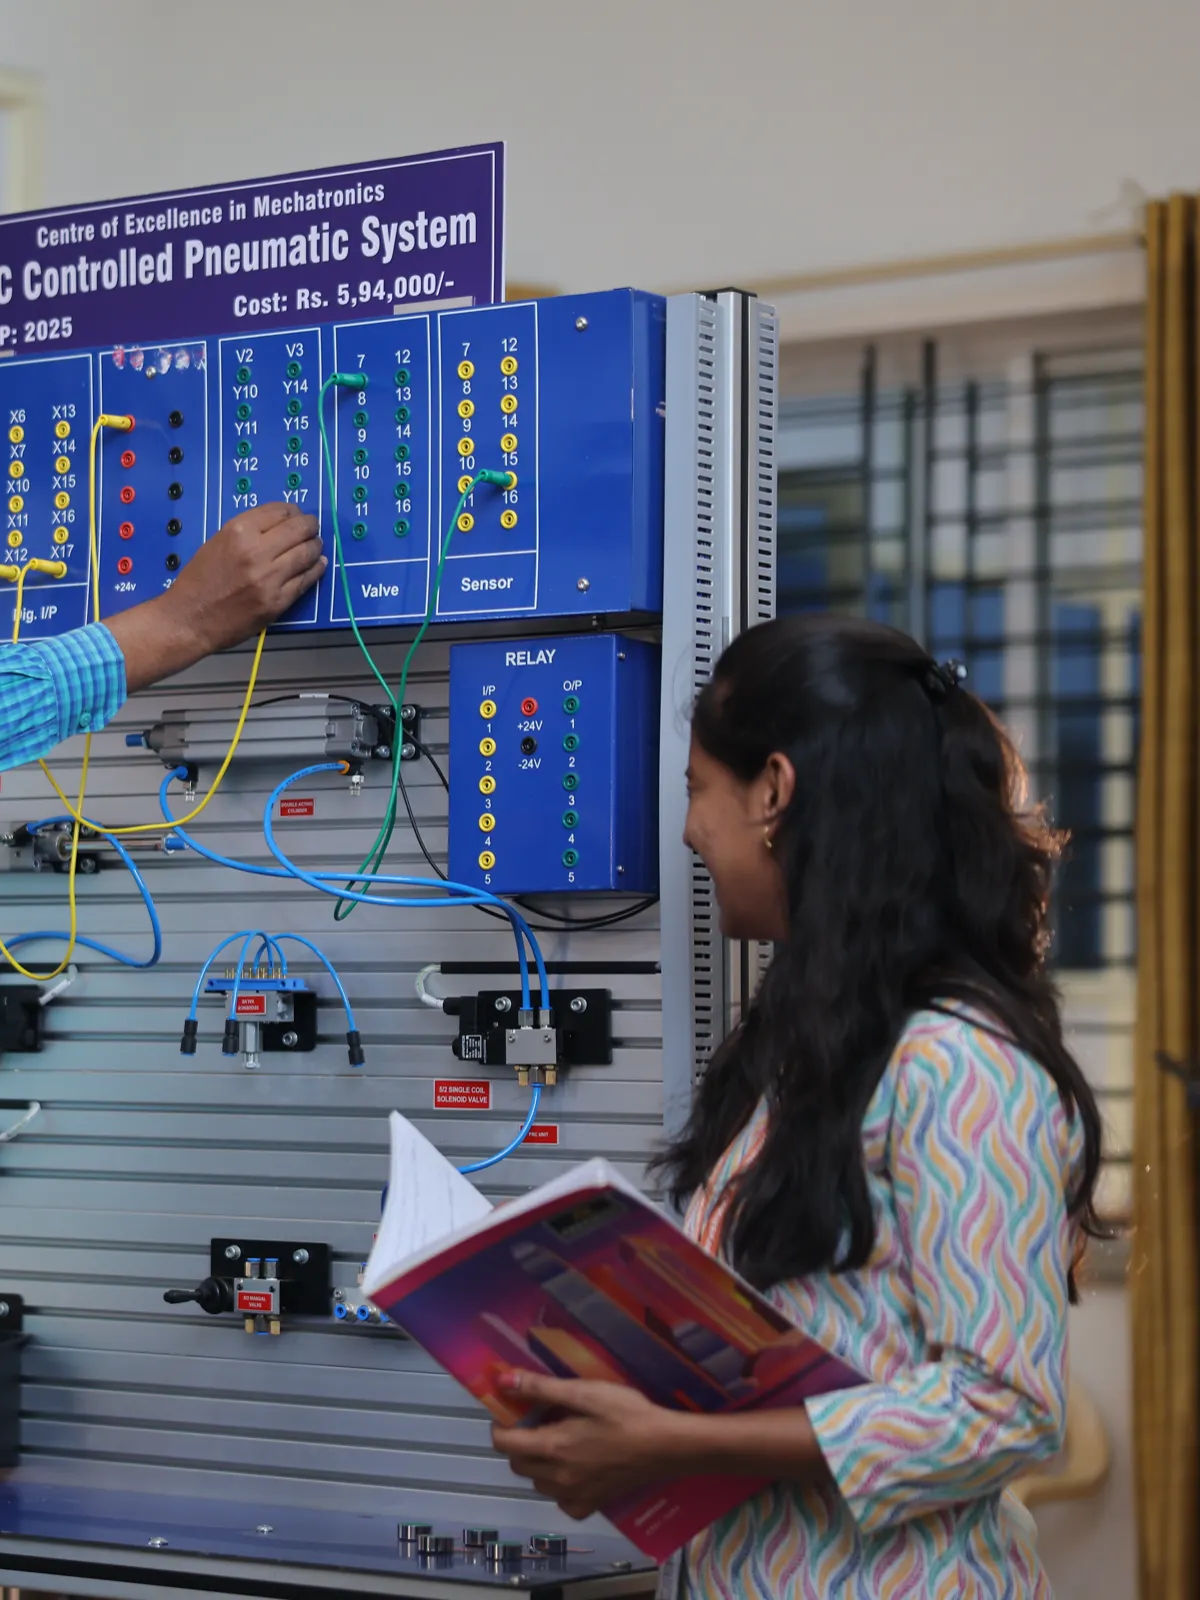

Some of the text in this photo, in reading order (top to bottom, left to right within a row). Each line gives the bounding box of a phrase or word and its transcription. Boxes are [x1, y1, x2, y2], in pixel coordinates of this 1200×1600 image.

[37, 183, 385, 248] Centre of Excellence in Mechatronics
[24, 242, 172, 300] Controlled
[184, 224, 348, 278] Pneumatic
[362, 211, 476, 263] System
[234, 272, 455, 317] Cost: Rs. 5,94,000/-
[25, 317, 72, 342] 2025
[285, 342, 304, 358] V3
[462, 342, 471, 357] 7
[501, 337, 518, 353] 12
[235, 348, 254, 364] V2
[357, 353, 366, 369] 7
[395, 348, 411, 365] 12
[282, 378, 309, 395] Y14
[462, 379, 472, 395] 8
[501, 374, 518, 391] 13
[232, 383, 259, 400] Y10
[357, 391, 367, 406] 8
[395, 386, 412, 402] 13
[10, 409, 26, 424] X6
[52, 403, 76, 420] X13
[234, 420, 257, 436] Y11
[283, 415, 309, 431] Y15
[462, 417, 472, 433] 9
[502, 412, 518, 429] 14
[357, 428, 367, 443] 9
[396, 423, 412, 439] 14
[10, 443, 27, 459] X7
[52, 438, 76, 455] X14
[233, 456, 259, 473] Y12
[283, 452, 309, 468] Y16
[459, 455, 476, 471] 10
[502, 450, 519, 467] 15
[354, 464, 370, 480] 10
[395, 461, 412, 476] 15
[6, 478, 30, 494] X10
[52, 474, 76, 490] X15
[232, 493, 259, 509] Y13
[282, 488, 309, 504] Y17
[502, 489, 519, 505] 16
[355, 502, 368, 517] 11
[395, 498, 412, 513] 16
[7, 513, 28, 529] X11
[51, 509, 76, 525] X16
[4, 547, 28, 563] X12
[50, 543, 75, 560] X17
[114, 581, 137, 593] +24v
[361, 583, 400, 598] Valve
[460, 577, 514, 592] Sensor
[40, 605, 58, 620] I/P
[505, 648, 556, 667] RELAY
[482, 684, 496, 696] I/P
[562, 679, 583, 692] O/P
[517, 720, 543, 732] +24V
[485, 760, 492, 772] 2
[518, 758, 542, 770] -24V
[568, 756, 576, 768] 2
[485, 798, 492, 809] 3
[568, 794, 575, 806] 3
[484, 836, 491, 847] 4
[568, 833, 575, 844] 4
[484, 873, 492, 885] 5
[568, 871, 575, 883] 5
[448, 1086, 471, 1094] SINGLE
[437, 1095, 488, 1104] SOLENOID VALVE
